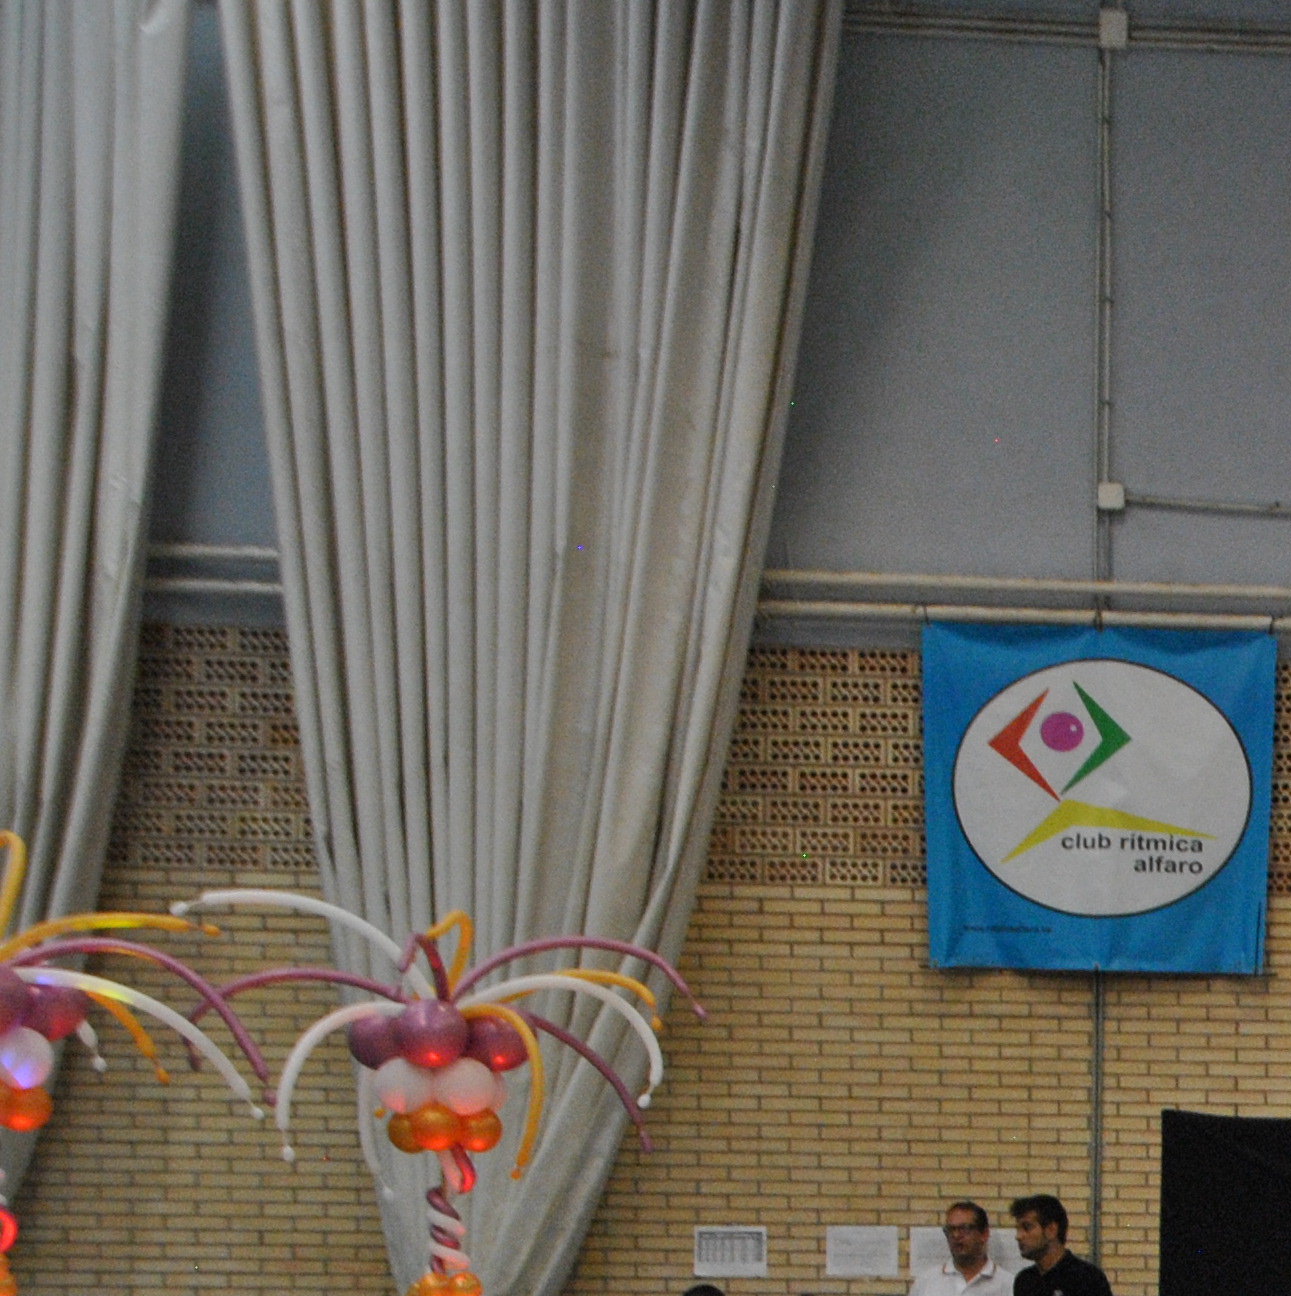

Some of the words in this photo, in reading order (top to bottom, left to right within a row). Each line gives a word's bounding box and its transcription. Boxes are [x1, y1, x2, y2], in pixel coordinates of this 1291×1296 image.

[1061, 832, 1111, 851] club
[1120, 831, 1203, 853] rítmica
[1134, 855, 1203, 874] alfaro
